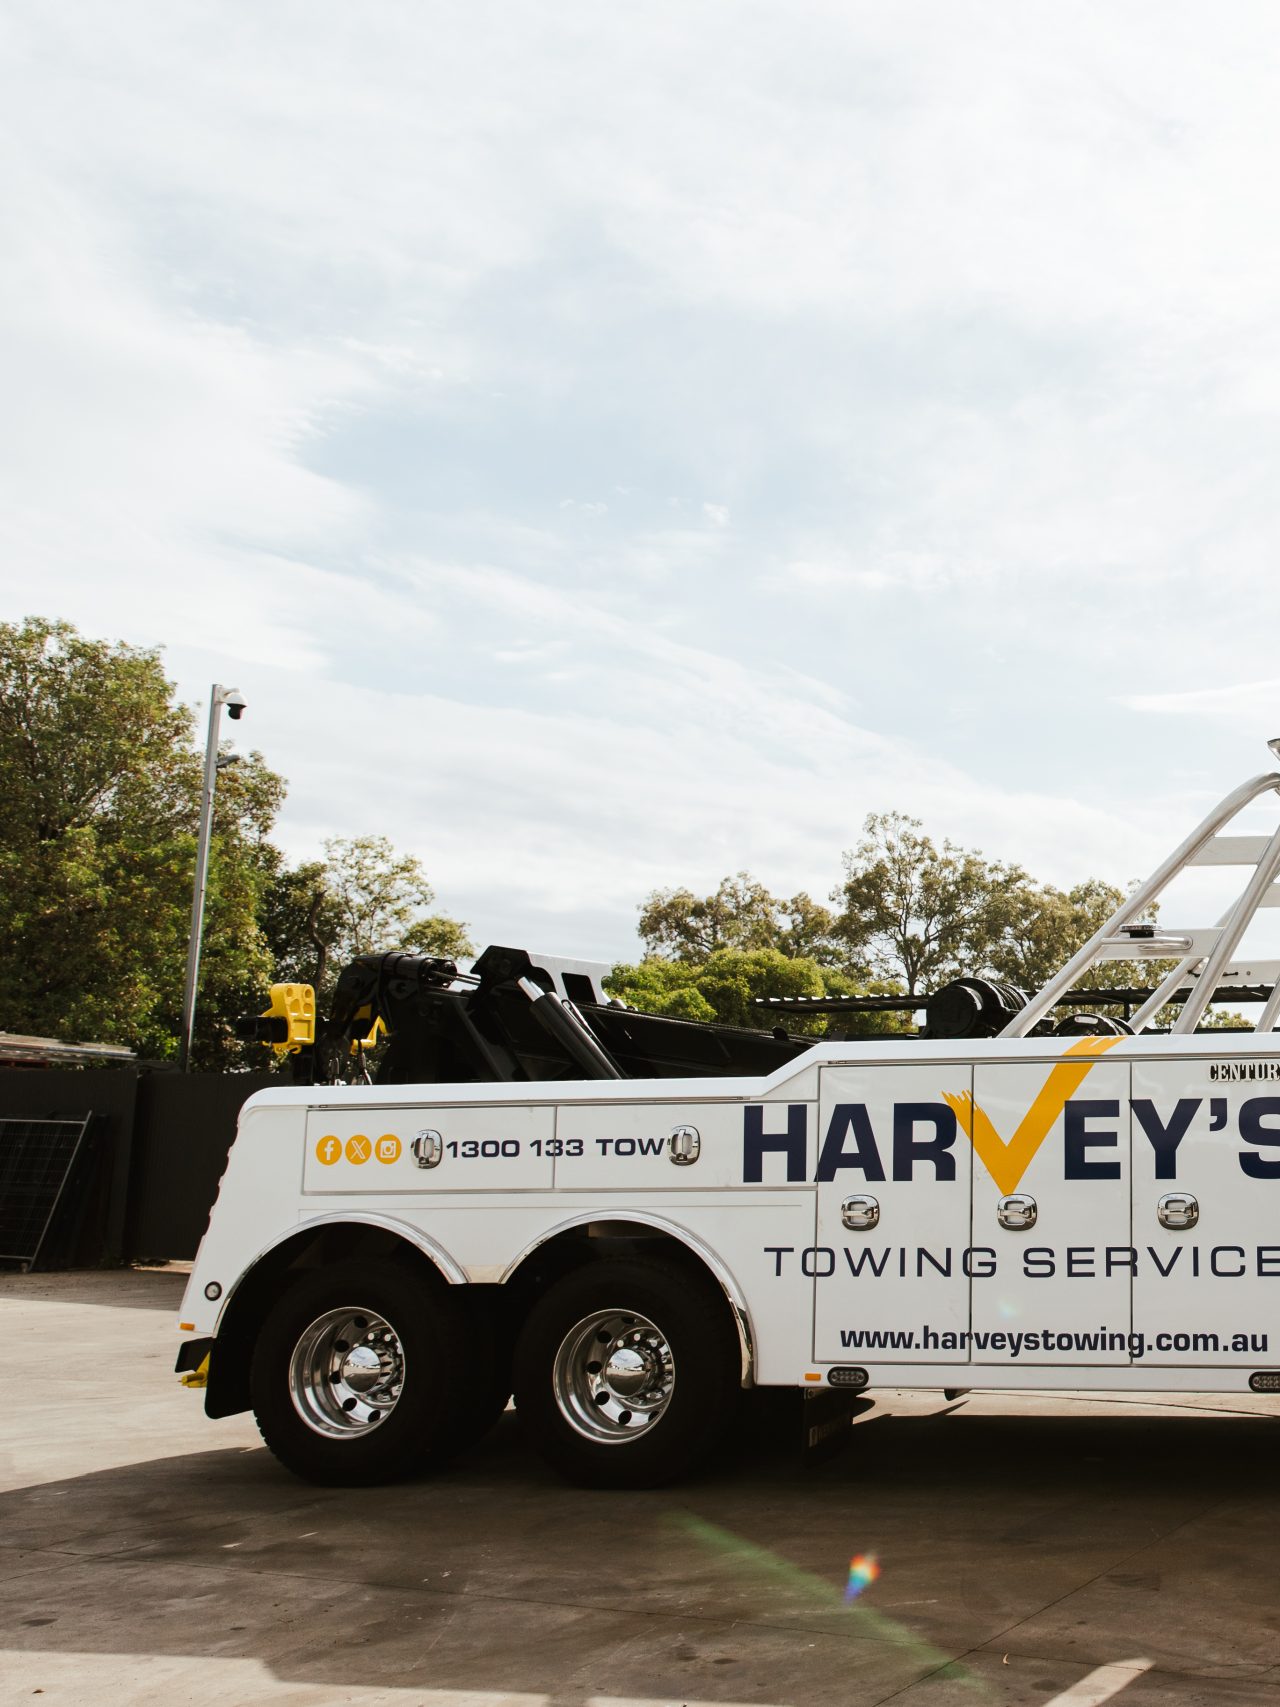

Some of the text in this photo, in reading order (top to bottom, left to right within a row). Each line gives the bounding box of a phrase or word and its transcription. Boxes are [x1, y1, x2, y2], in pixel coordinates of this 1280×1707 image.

[446, 1137, 665, 1159] 1300 133 TOW
[763, 1246, 998, 1278] TOWING
[840, 1325, 1269, 1359] www.harveystowing.com.au
